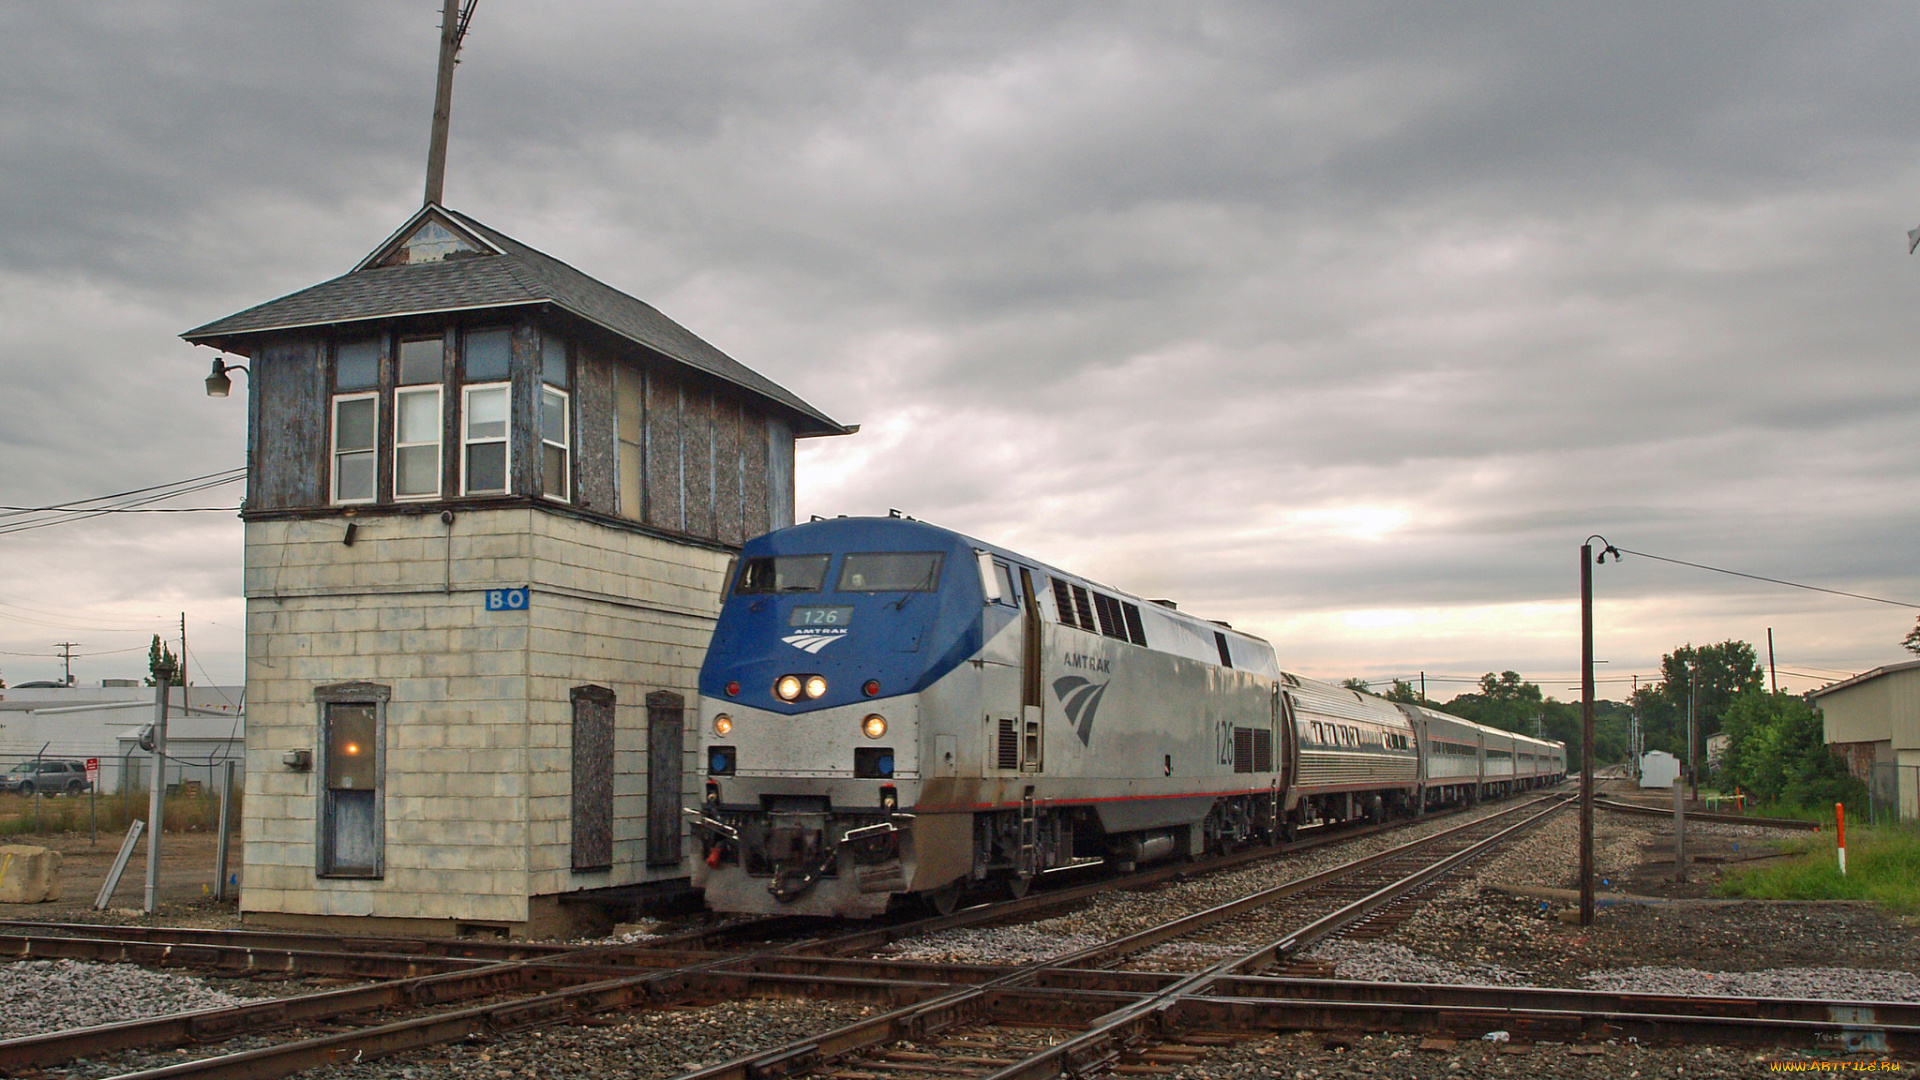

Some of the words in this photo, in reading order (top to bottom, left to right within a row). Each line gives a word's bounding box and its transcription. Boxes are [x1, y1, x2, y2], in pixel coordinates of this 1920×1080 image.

[805, 610, 838, 624] 126
[1064, 652, 1110, 673] AMTRAK
[1215, 720, 1233, 765] 126
